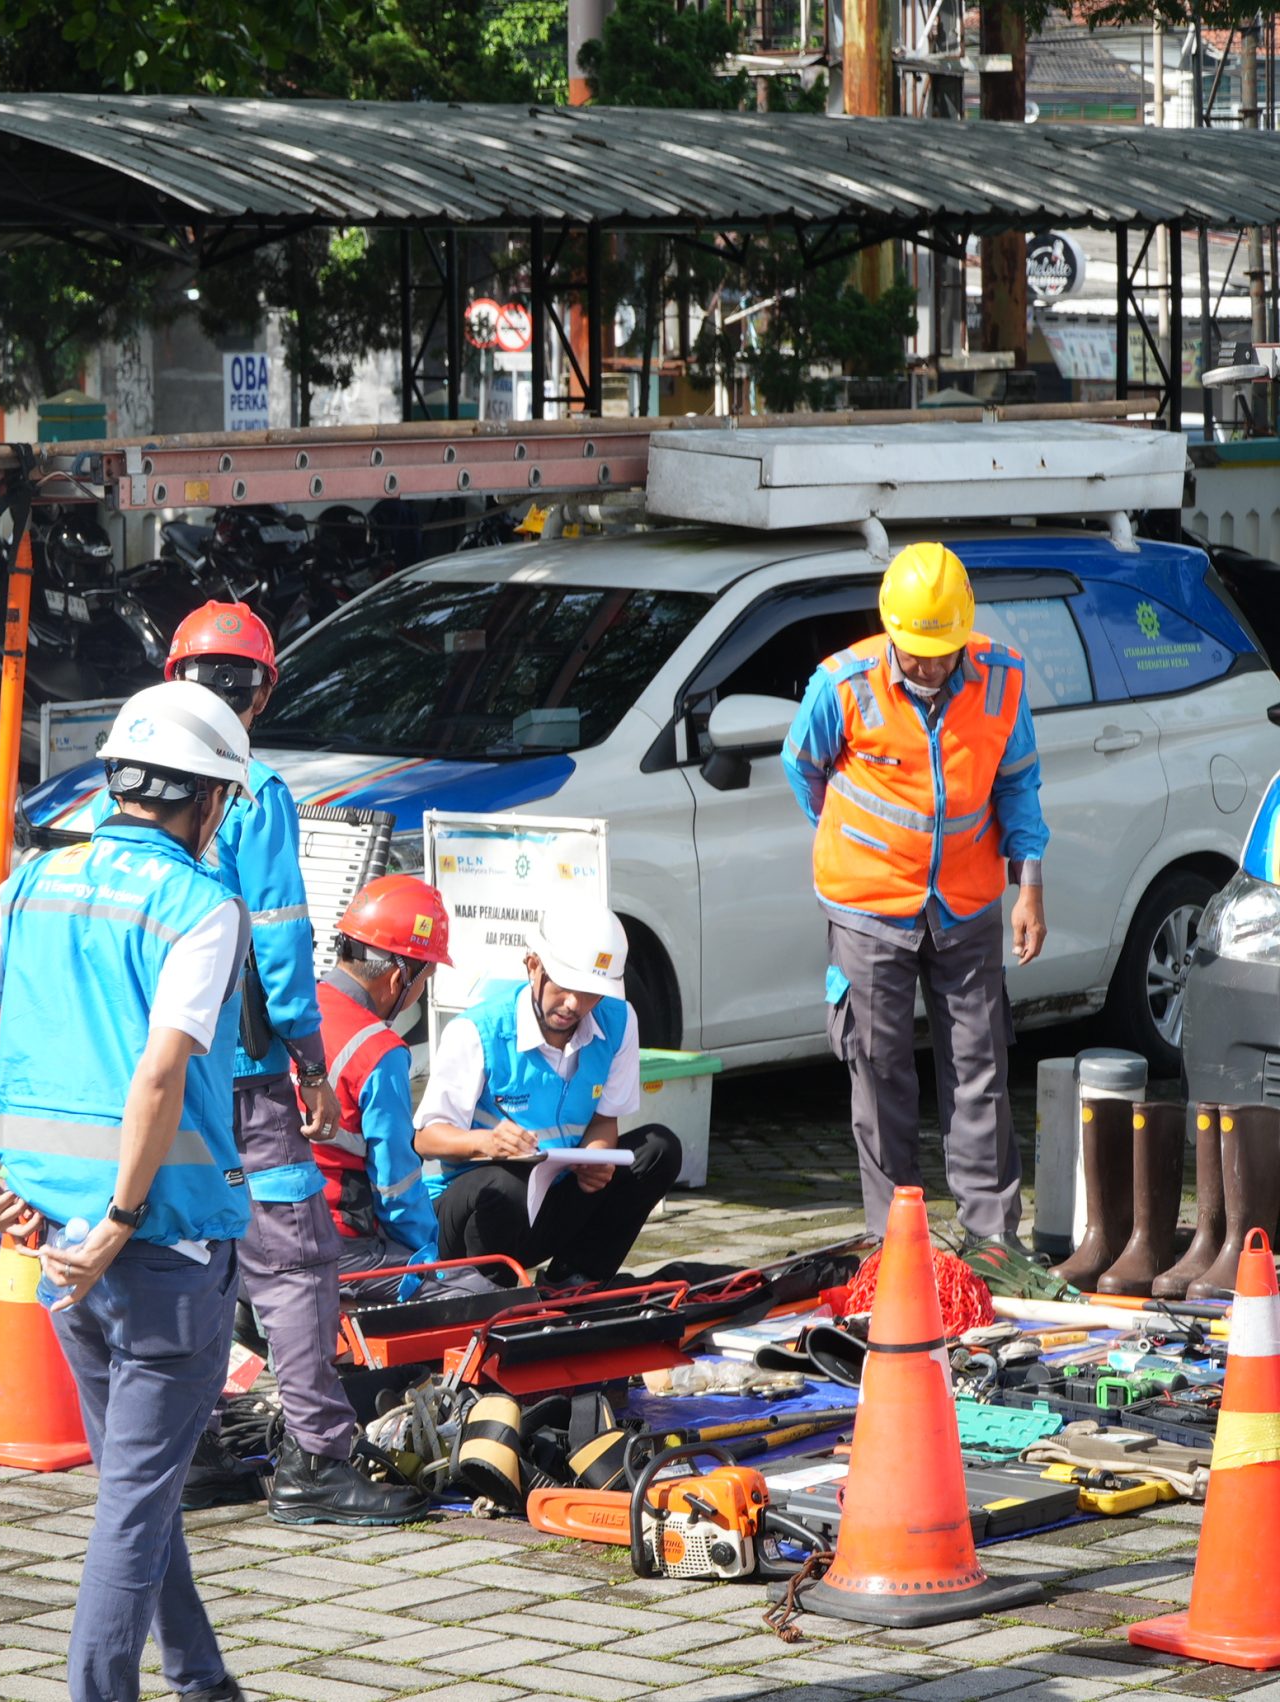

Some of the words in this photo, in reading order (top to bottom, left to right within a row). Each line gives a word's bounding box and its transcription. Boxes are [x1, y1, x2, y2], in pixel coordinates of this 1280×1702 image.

[91, 841, 173, 881] PLN
[457, 855, 484, 866] PLN
[573, 866, 596, 876] PLN
[454, 904, 477, 918] MAAF
[479, 905, 520, 921] PERJALANAN
[520, 908, 539, 923] ANDA
[410, 935, 429, 947] PLN
[485, 931, 498, 945] ADA
[592, 968, 608, 977] PLN
